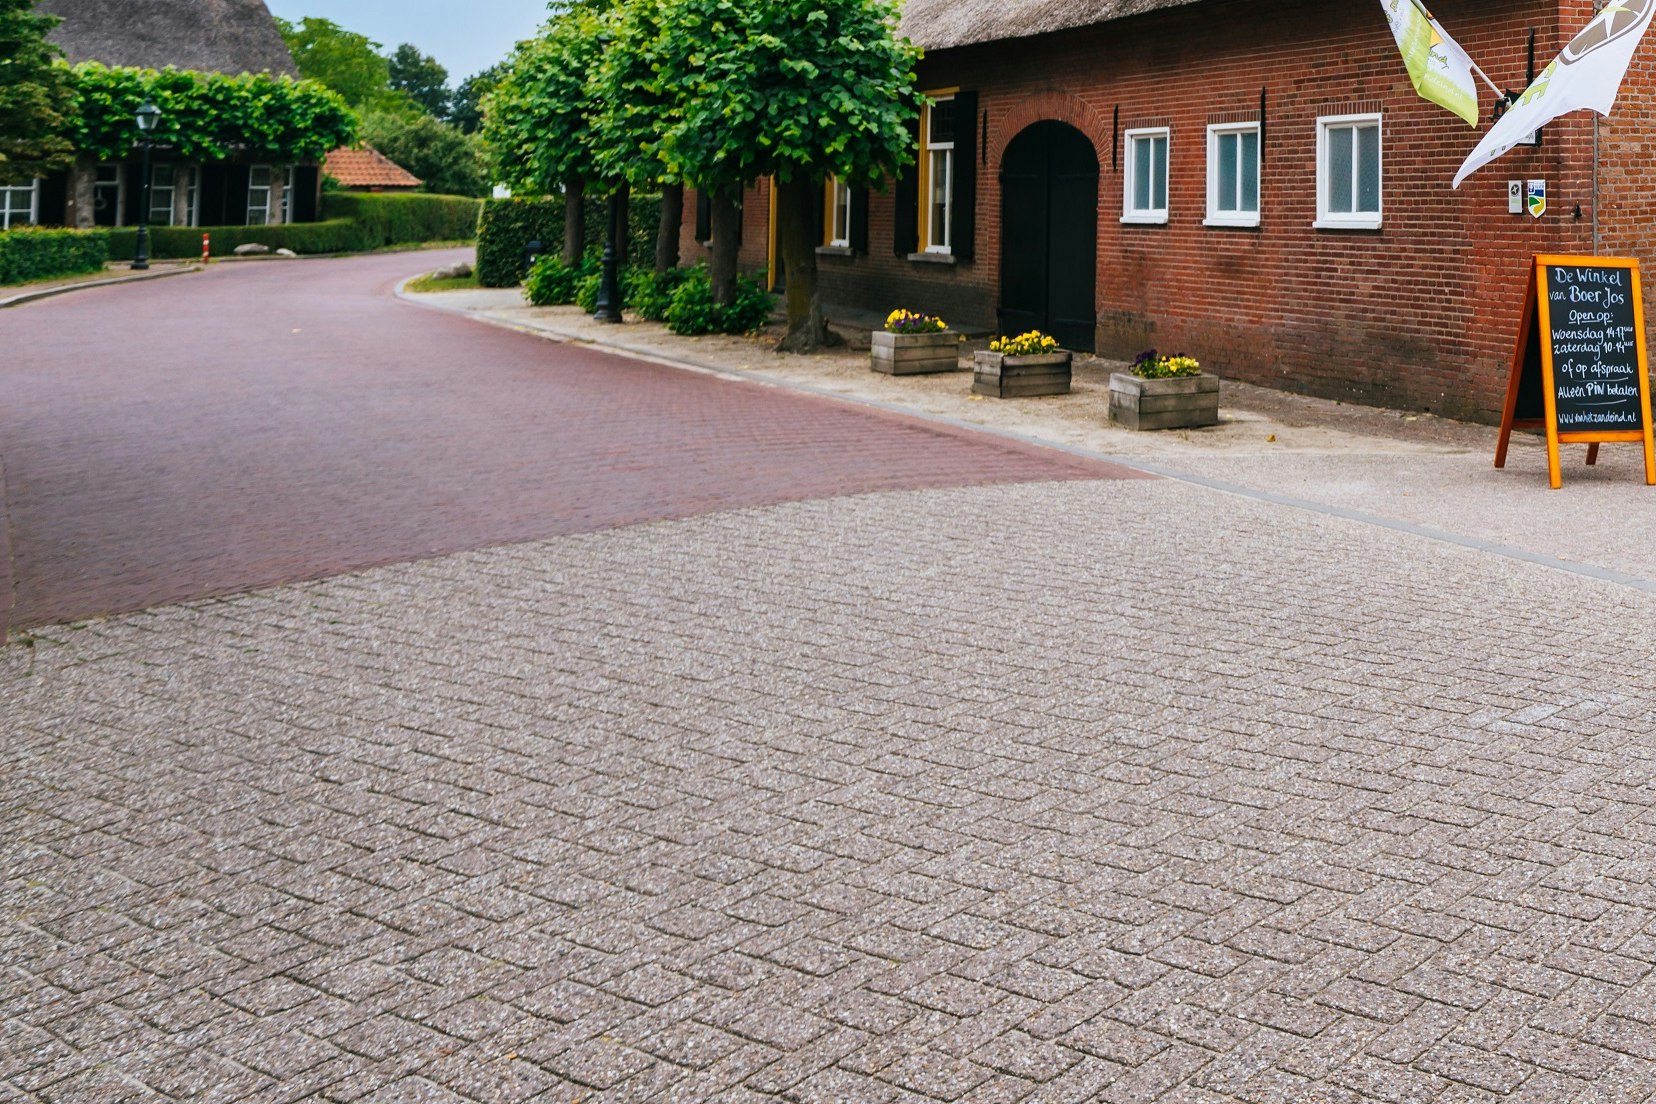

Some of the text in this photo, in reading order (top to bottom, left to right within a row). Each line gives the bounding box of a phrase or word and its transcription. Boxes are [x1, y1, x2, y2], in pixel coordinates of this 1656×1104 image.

[1555, 267, 1622, 286] De Winkel
[1549, 285, 1624, 309] van Boer Jos
[1568, 309, 1614, 326] Open op:
[1553, 342, 1601, 361] zaterdag
[1561, 358, 1634, 379] of op afspraak
[1557, 385, 1586, 399] Alleen
[1607, 383, 1638, 397] betalen
